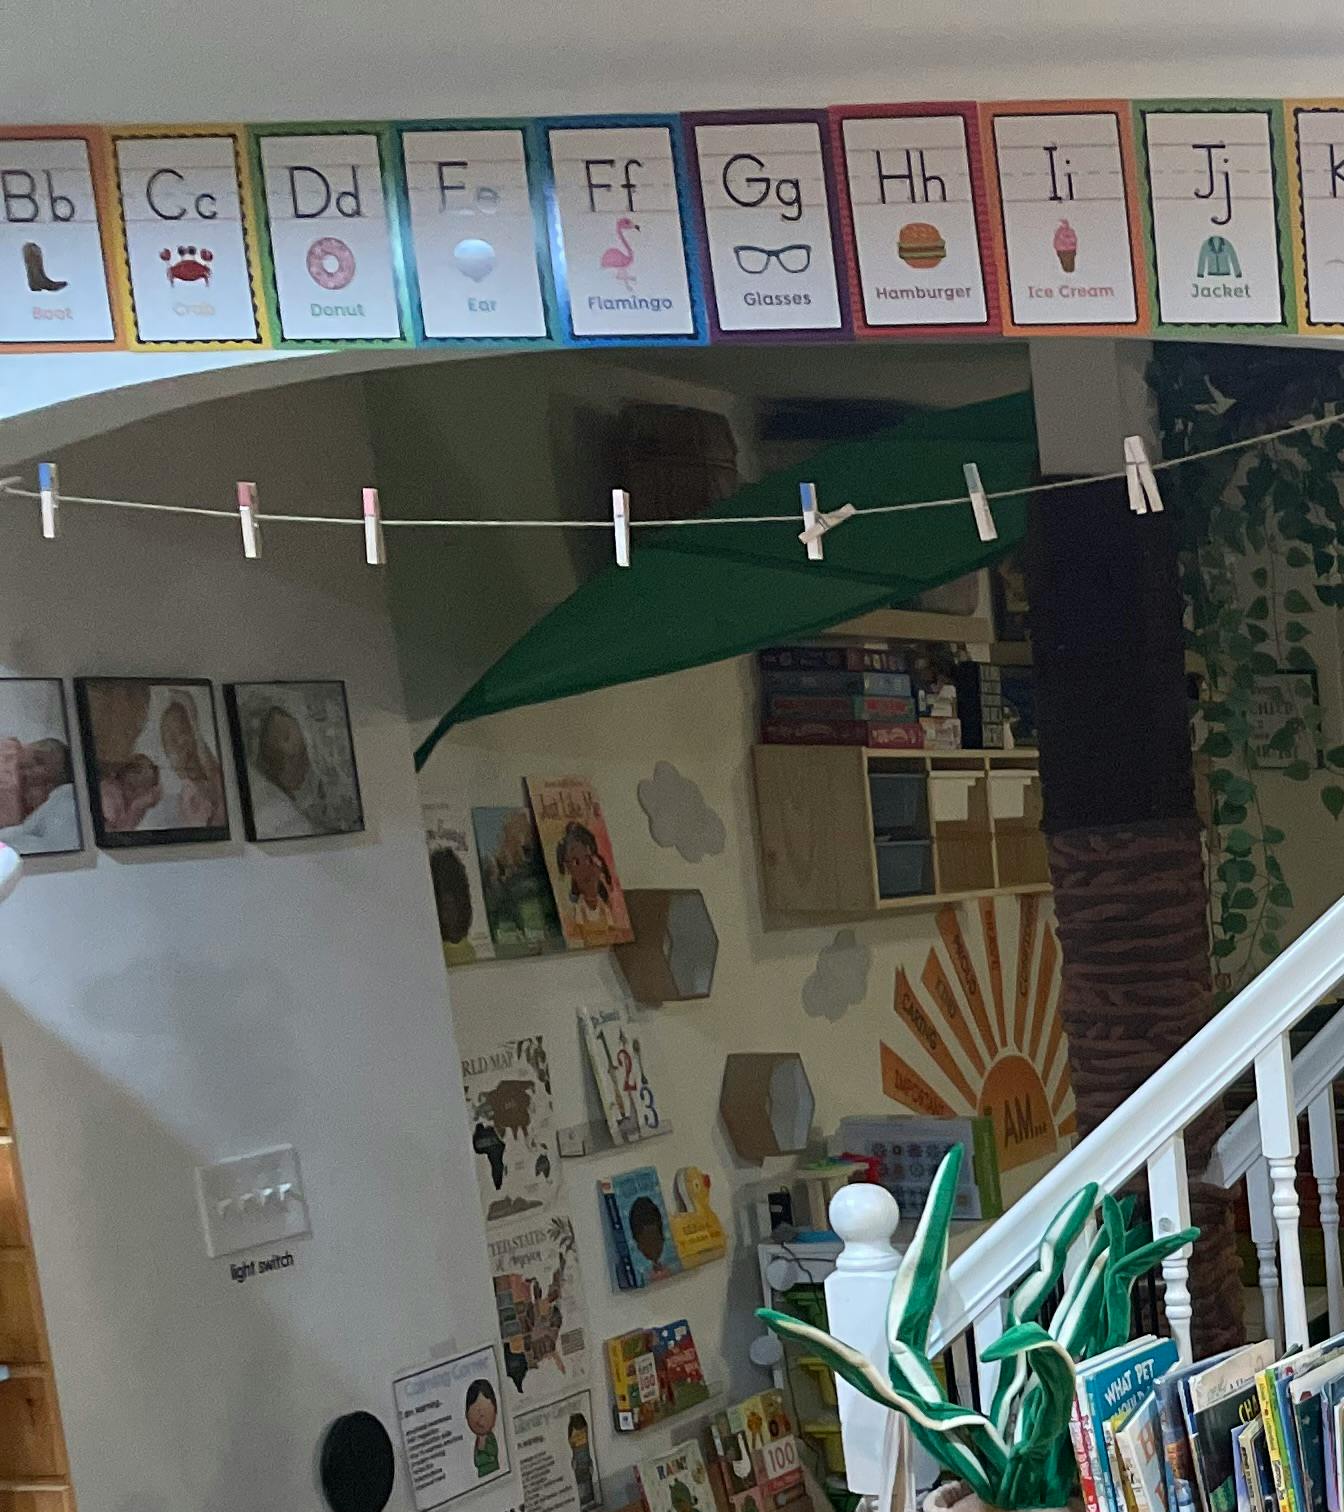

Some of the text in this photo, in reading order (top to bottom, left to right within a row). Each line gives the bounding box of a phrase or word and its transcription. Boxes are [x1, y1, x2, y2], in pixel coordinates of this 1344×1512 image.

[147, 168, 217, 220] Cc
[290, 166, 361, 219] Dd
[584, 160, 643, 212] Ff
[722, 154, 803, 220] Gg
[876, 150, 947, 205] Hh
[1192, 143, 1234, 225] Jj
[588, 293, 672, 313] Flamingo
[743, 290, 811, 307] Glasses
[876, 283, 971, 304] Hamburger
[1190, 281, 1250, 301] Jacket
[231, 1251, 293, 1282] light switch
[1104, 1370, 1132, 1407] WHAT
[1134, 1359, 1155, 1386] PET
